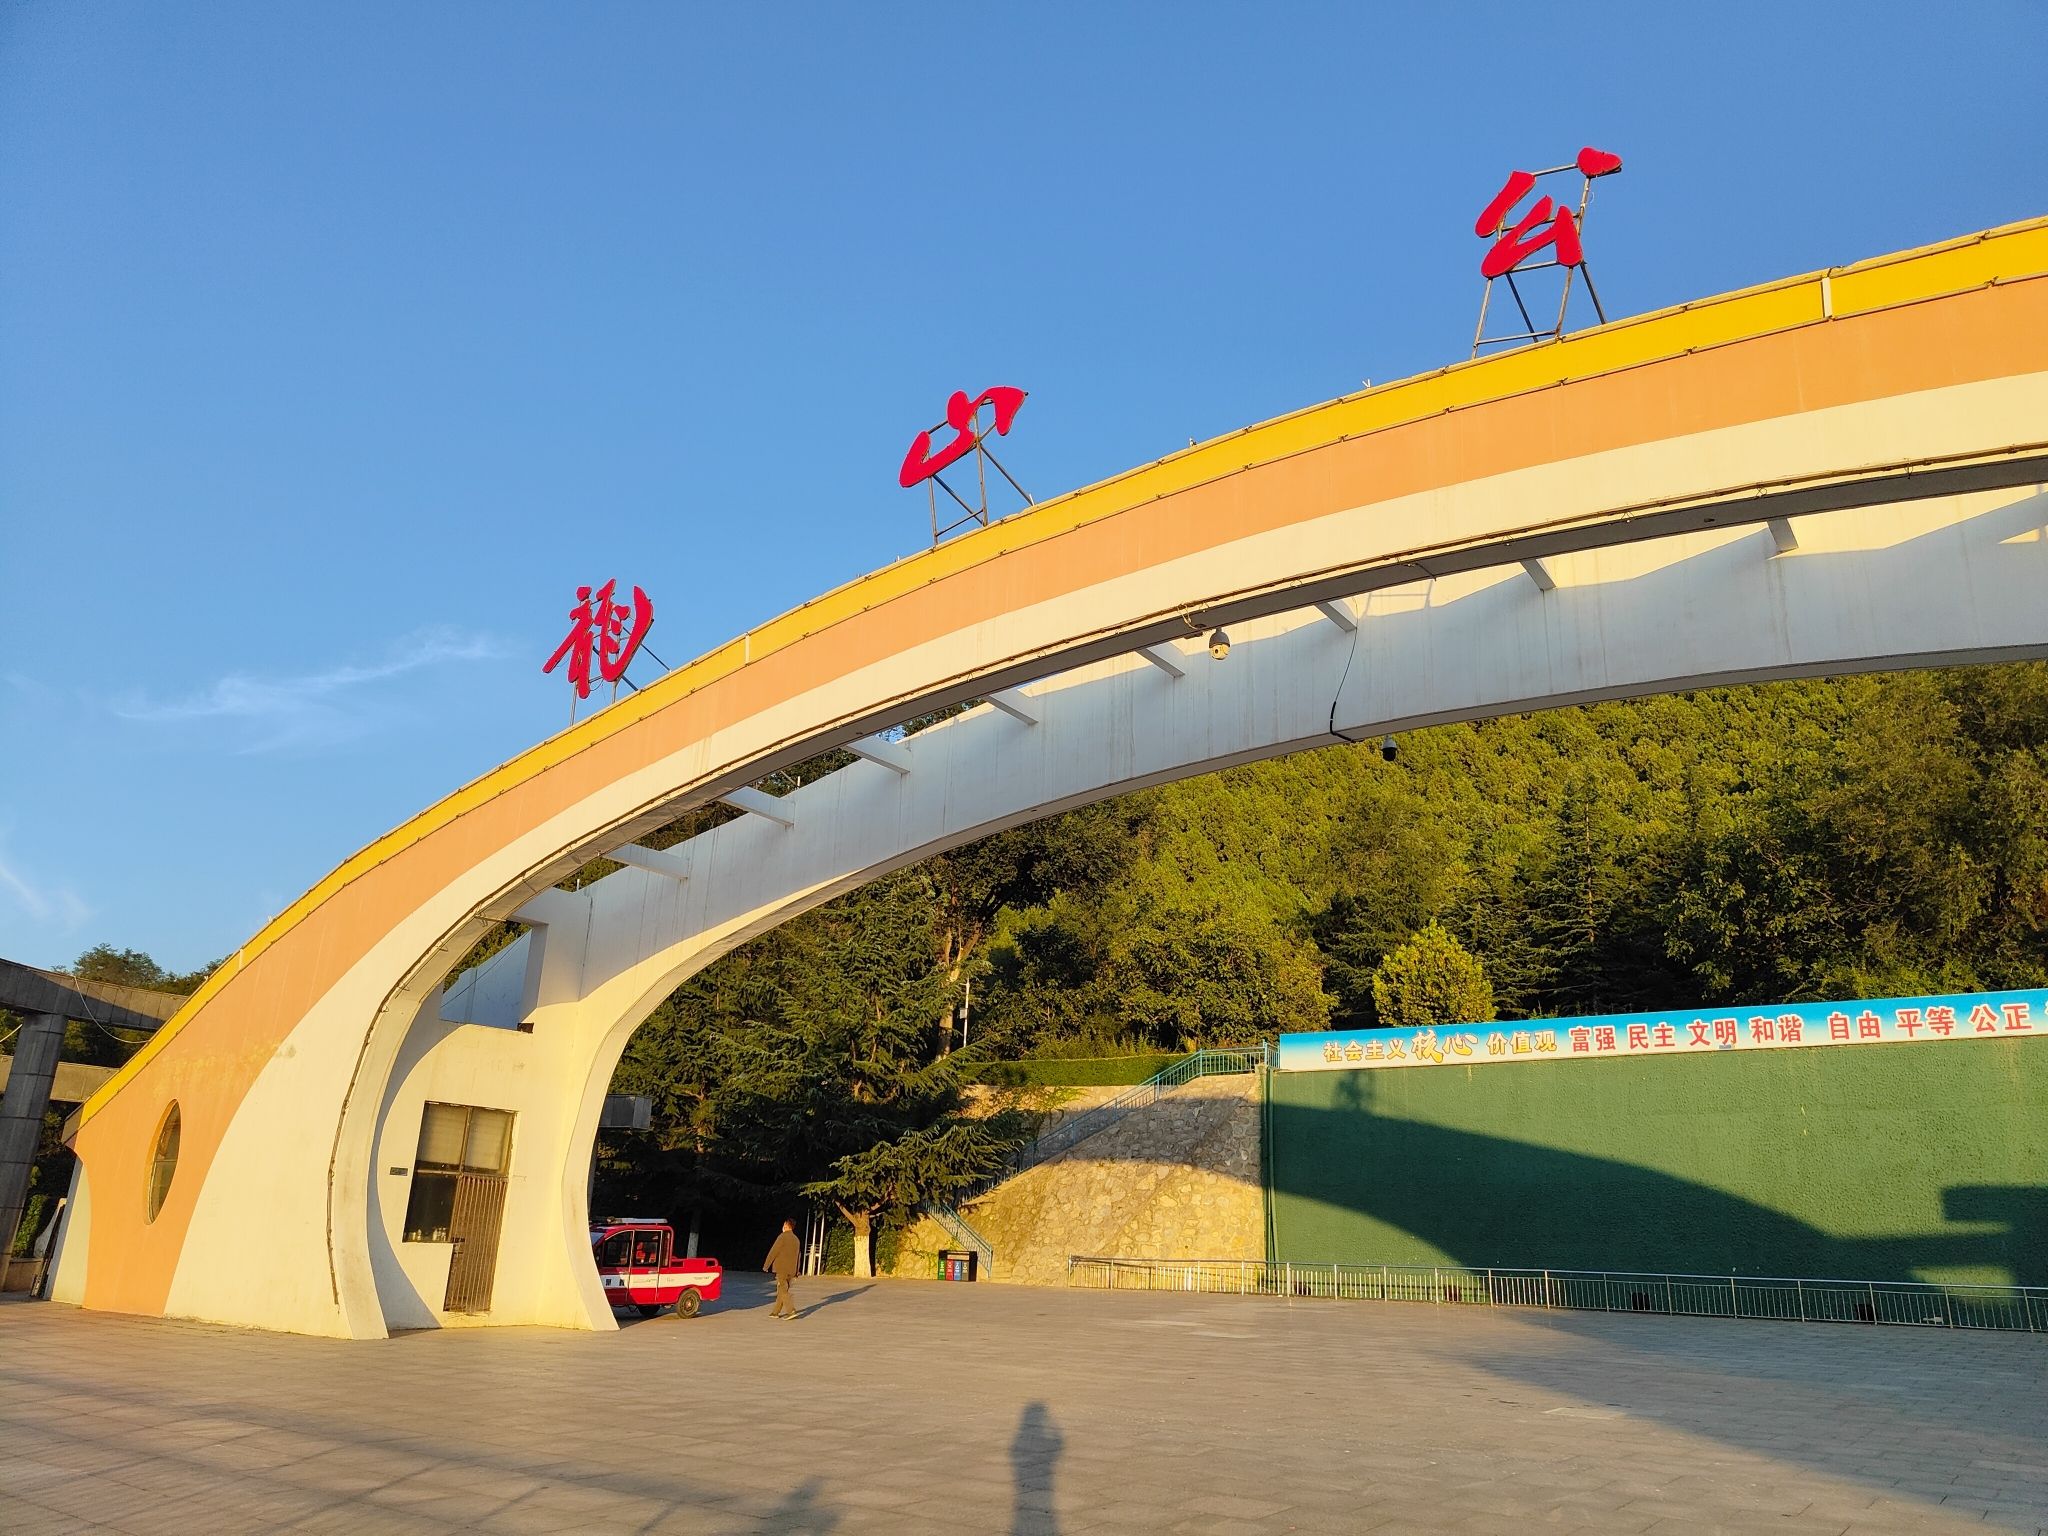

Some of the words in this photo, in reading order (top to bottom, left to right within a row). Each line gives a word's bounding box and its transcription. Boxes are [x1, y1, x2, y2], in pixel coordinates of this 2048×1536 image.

[1323, 1039, 1406, 1062] 社会主义
[1411, 1029, 1478, 1063] 核心
[1486, 1031, 1557, 1054] 价值观
[1570, 1026, 1617, 1052] 富强
[1628, 1023, 1676, 1048] 民主
[1688, 1019, 1738, 1046] 文明
[1751, 1014, 1803, 1043] 和谐
[1829, 1012, 1881, 1040] 自由
[1896, 1006, 1955, 1037] 平等
[1970, 1004, 2033, 1032] 公正
